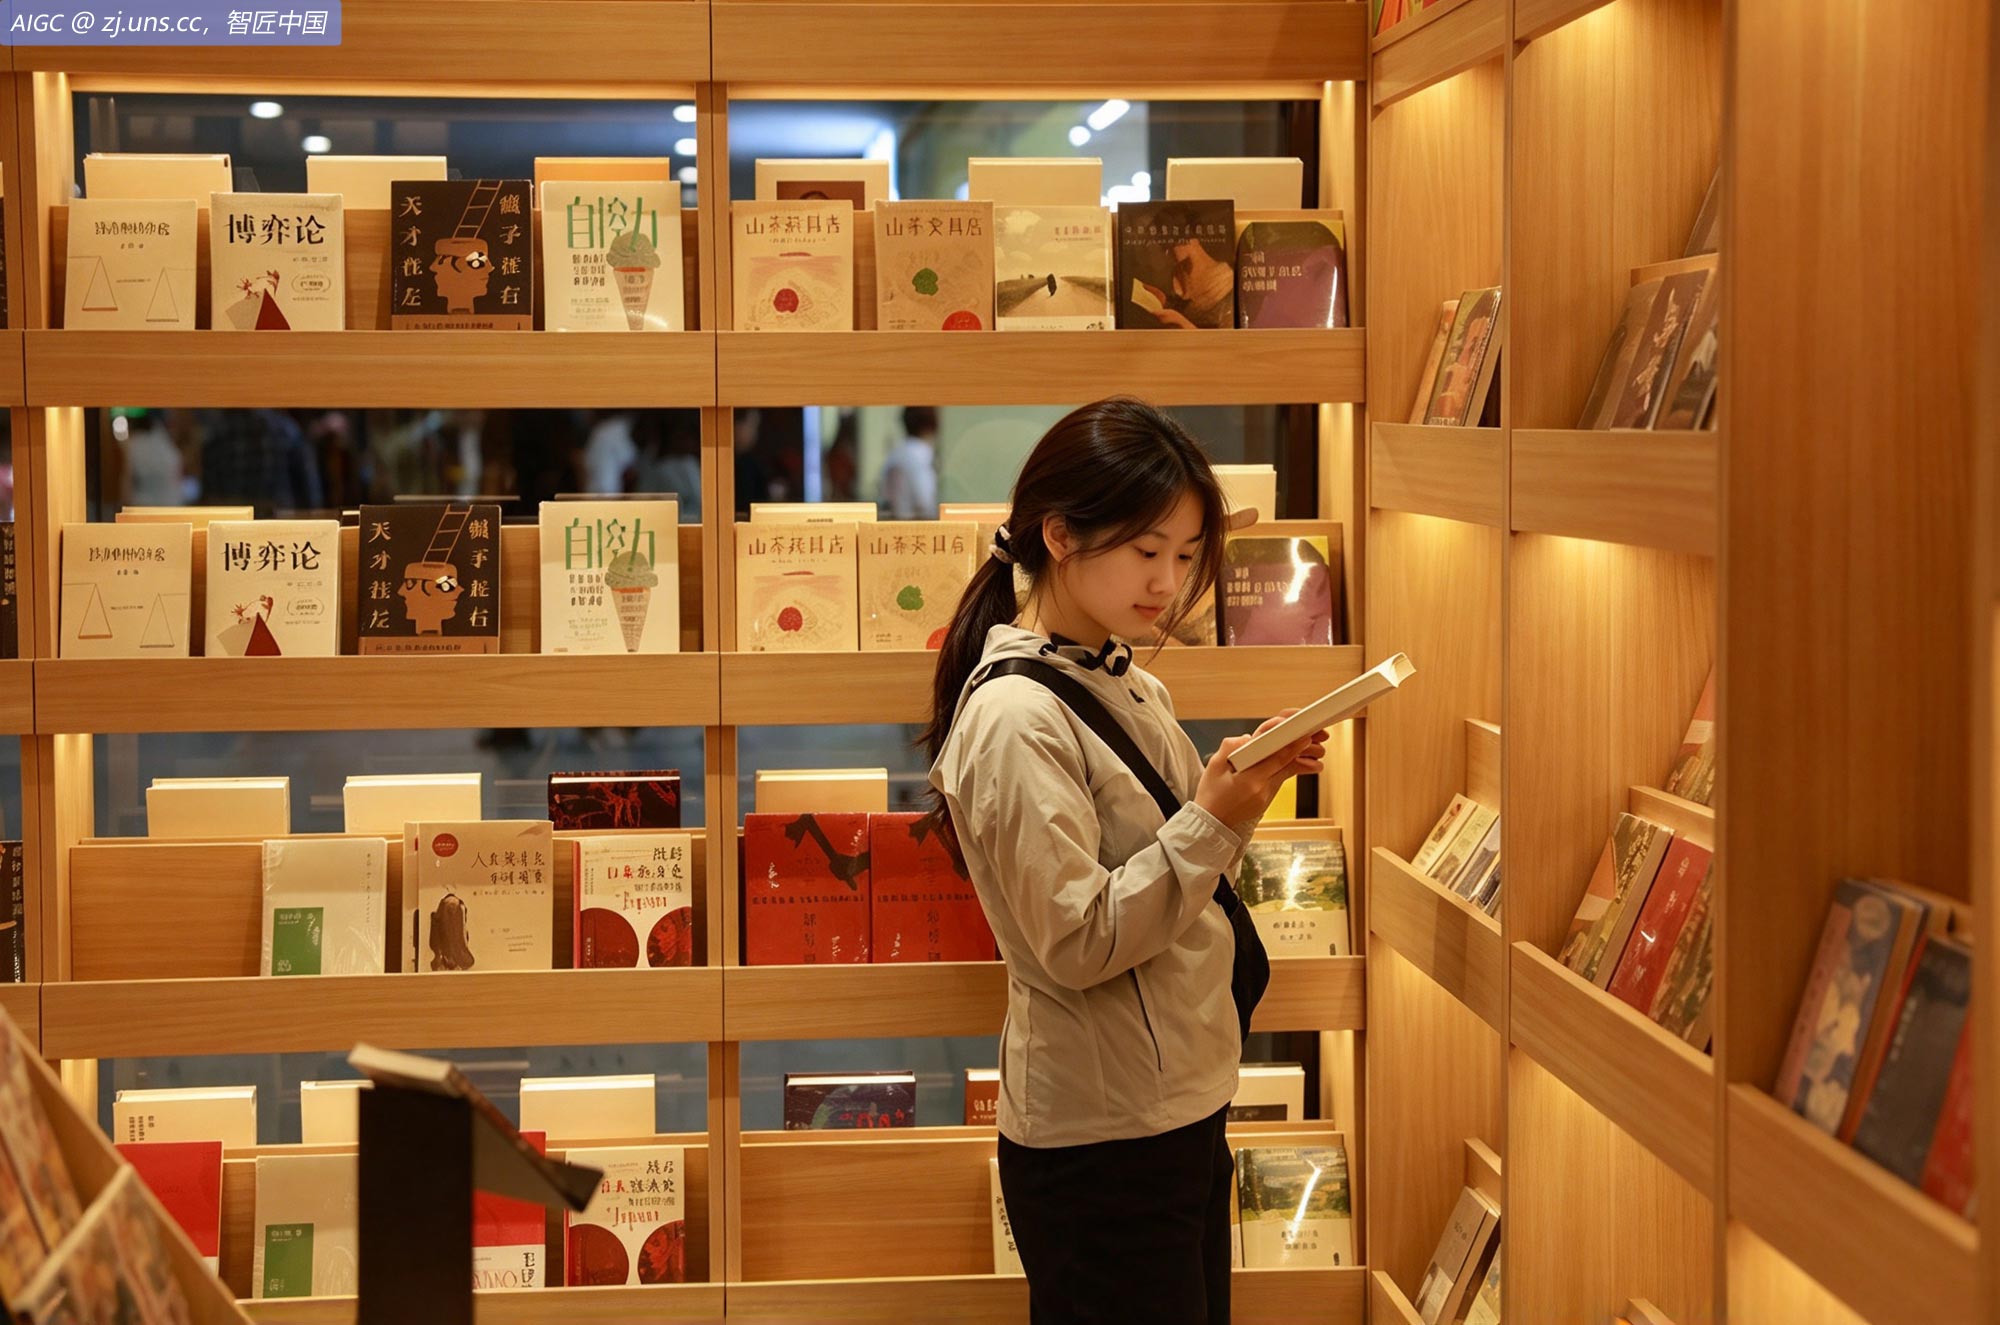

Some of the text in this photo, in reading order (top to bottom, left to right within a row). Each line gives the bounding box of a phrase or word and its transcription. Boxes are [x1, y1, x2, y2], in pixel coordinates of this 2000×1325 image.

[224, 214, 326, 245] 博弈论
[223, 541, 321, 572] 博弈论
